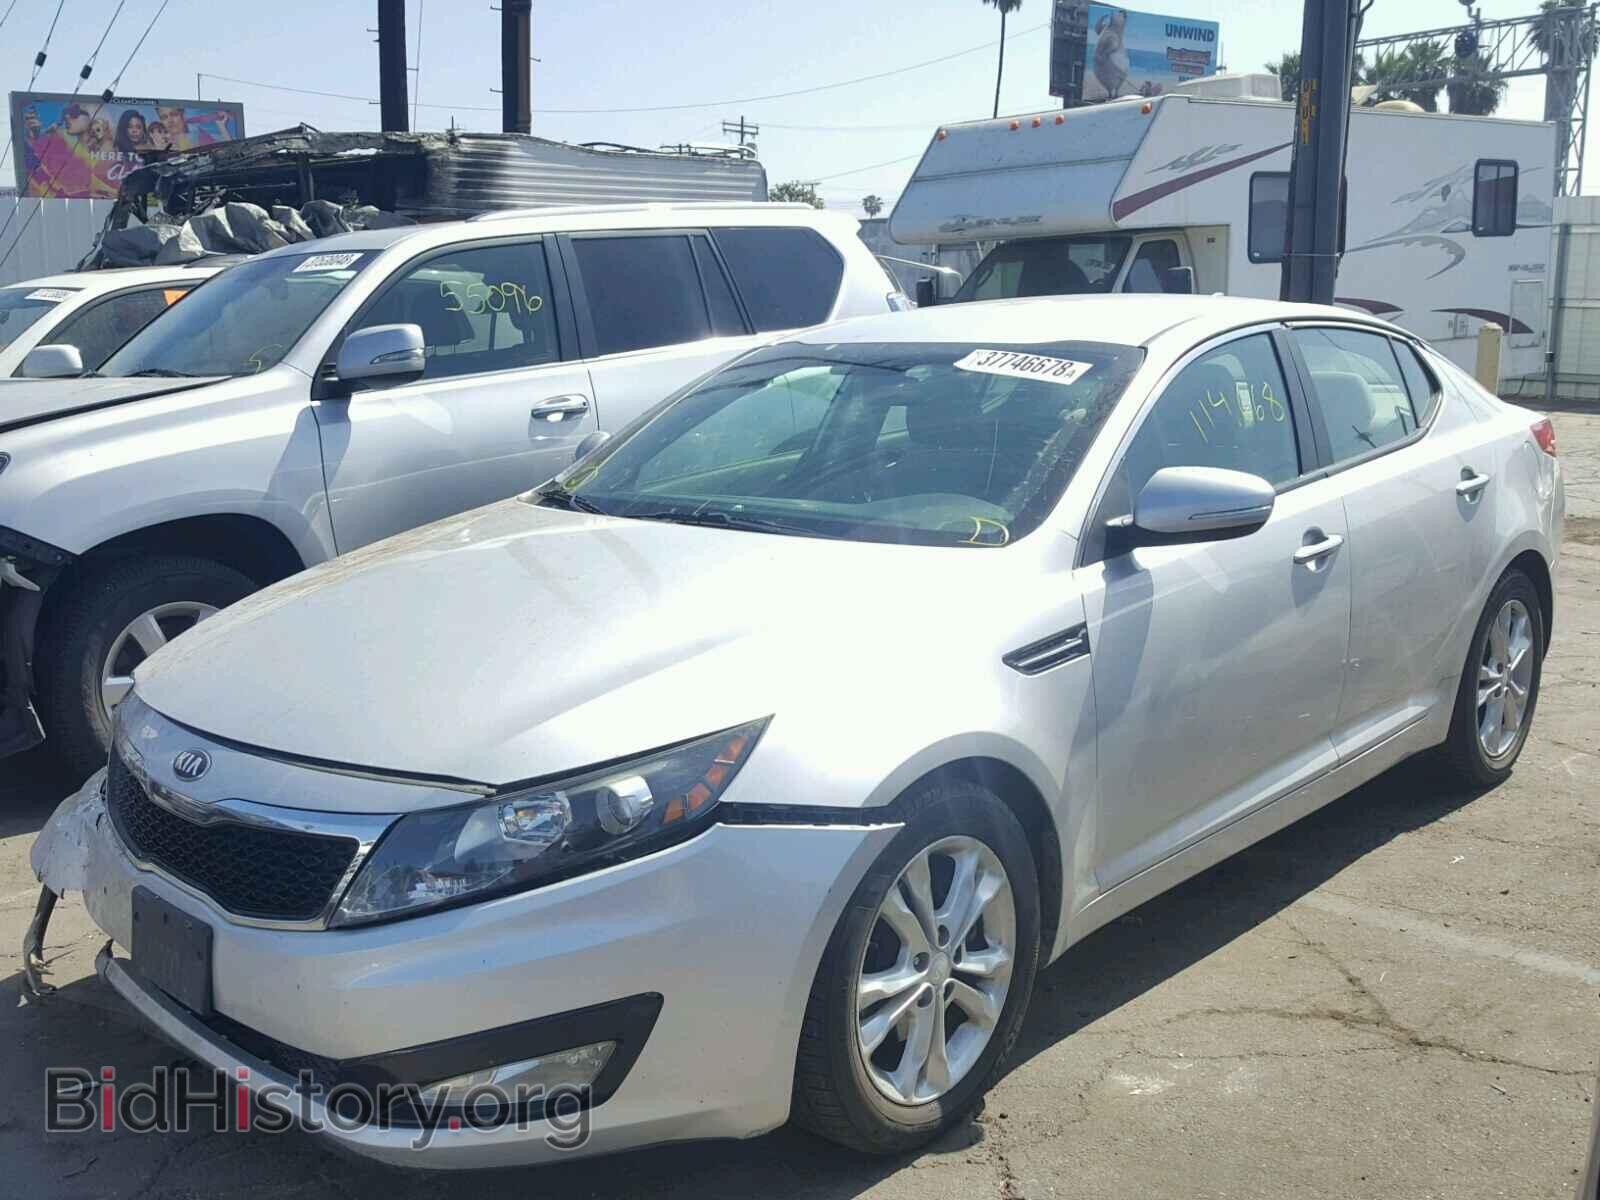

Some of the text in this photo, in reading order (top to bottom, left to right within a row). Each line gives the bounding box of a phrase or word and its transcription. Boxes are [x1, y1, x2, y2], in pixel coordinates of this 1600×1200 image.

[1165, 23, 1215, 42] UNWIND
[89, 151, 123, 161] HERE
[175, 751, 202, 776] KIA
